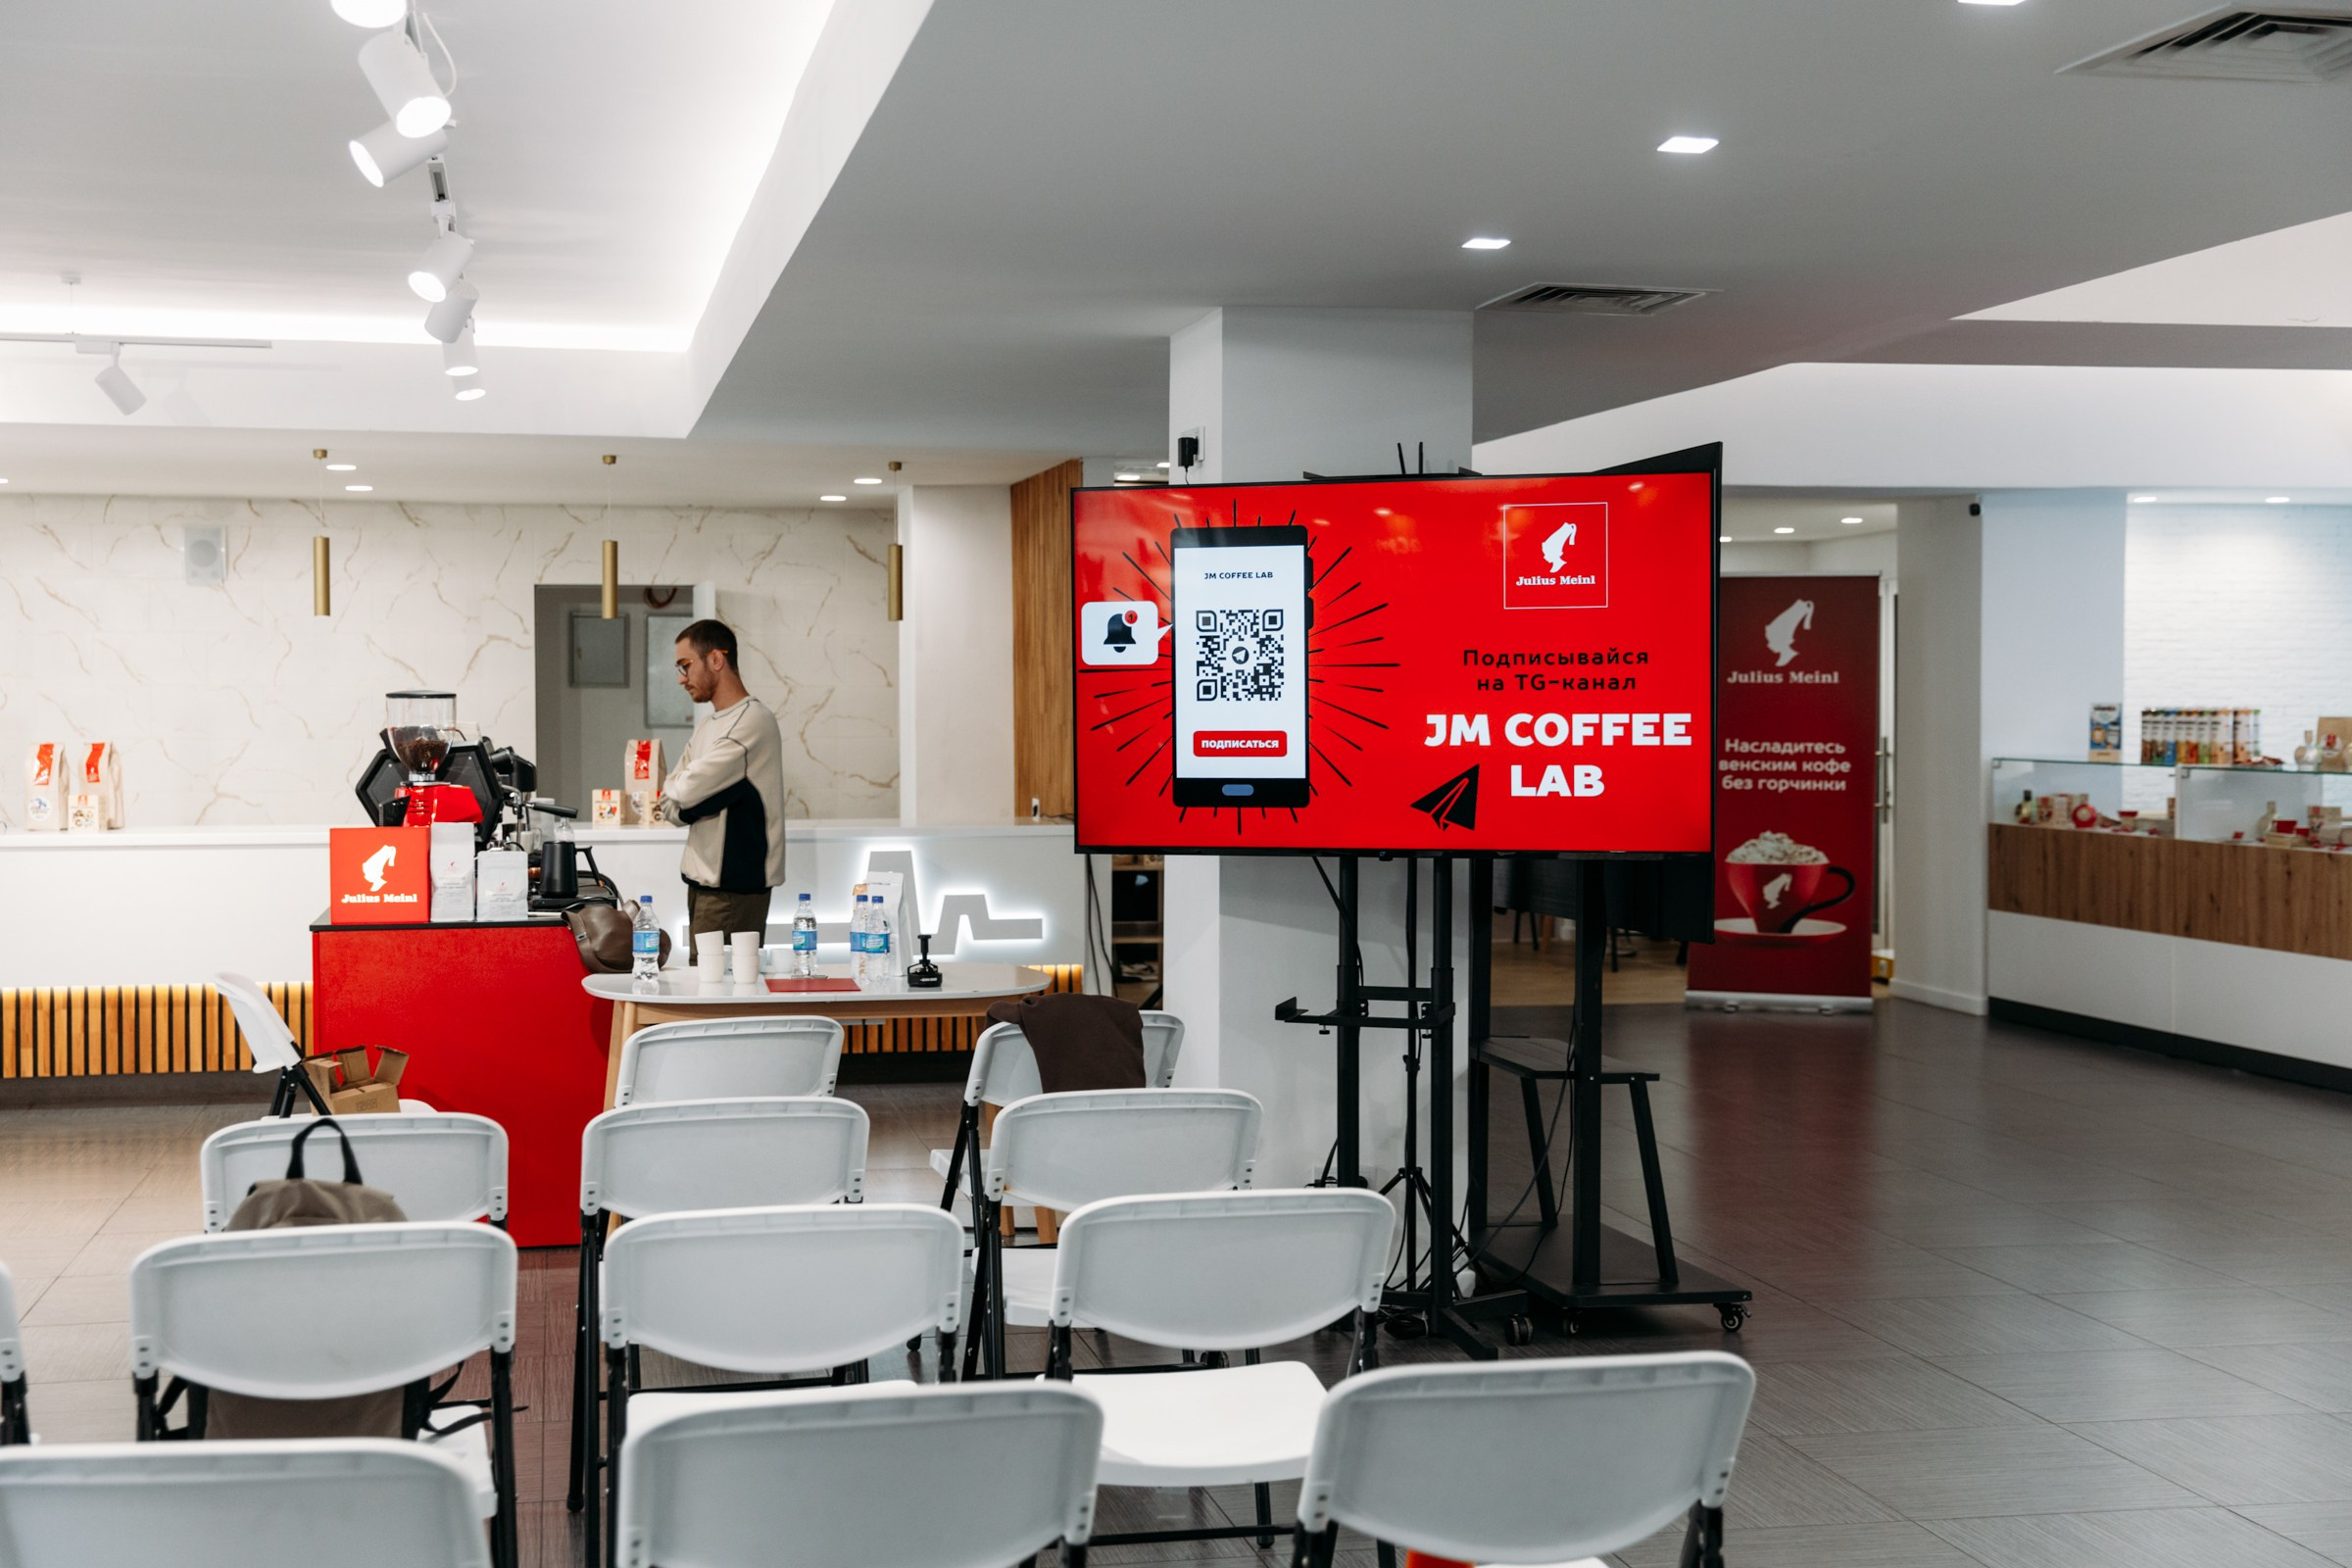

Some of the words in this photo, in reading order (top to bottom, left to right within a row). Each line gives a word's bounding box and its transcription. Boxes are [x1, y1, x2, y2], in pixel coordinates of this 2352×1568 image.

[1516, 576, 1556, 587] Julius
[1559, 574, 1595, 586] Meinl
[1463, 647, 1649, 668] Подписывайся
[1478, 677, 1504, 691] на
[1515, 674, 1636, 691] TG-канал
[1727, 670, 1784, 684] Julius
[1788, 670, 1839, 684] Meinl
[1424, 713, 1491, 747] JM
[1504, 712, 1692, 747] COFFEE
[1201, 739, 1279, 750] ПОДПИСАТЬСЯ
[1725, 738, 1845, 755] Насладитесь
[1719, 760, 1797, 772] венским
[1802, 759, 1851, 775] кофе
[1510, 764, 1605, 797] LAB
[1722, 775, 1753, 790] без
[1758, 777, 1846, 793] горчинки
[341, 893, 380, 904] Julius
[383, 893, 417, 904] Meinl
